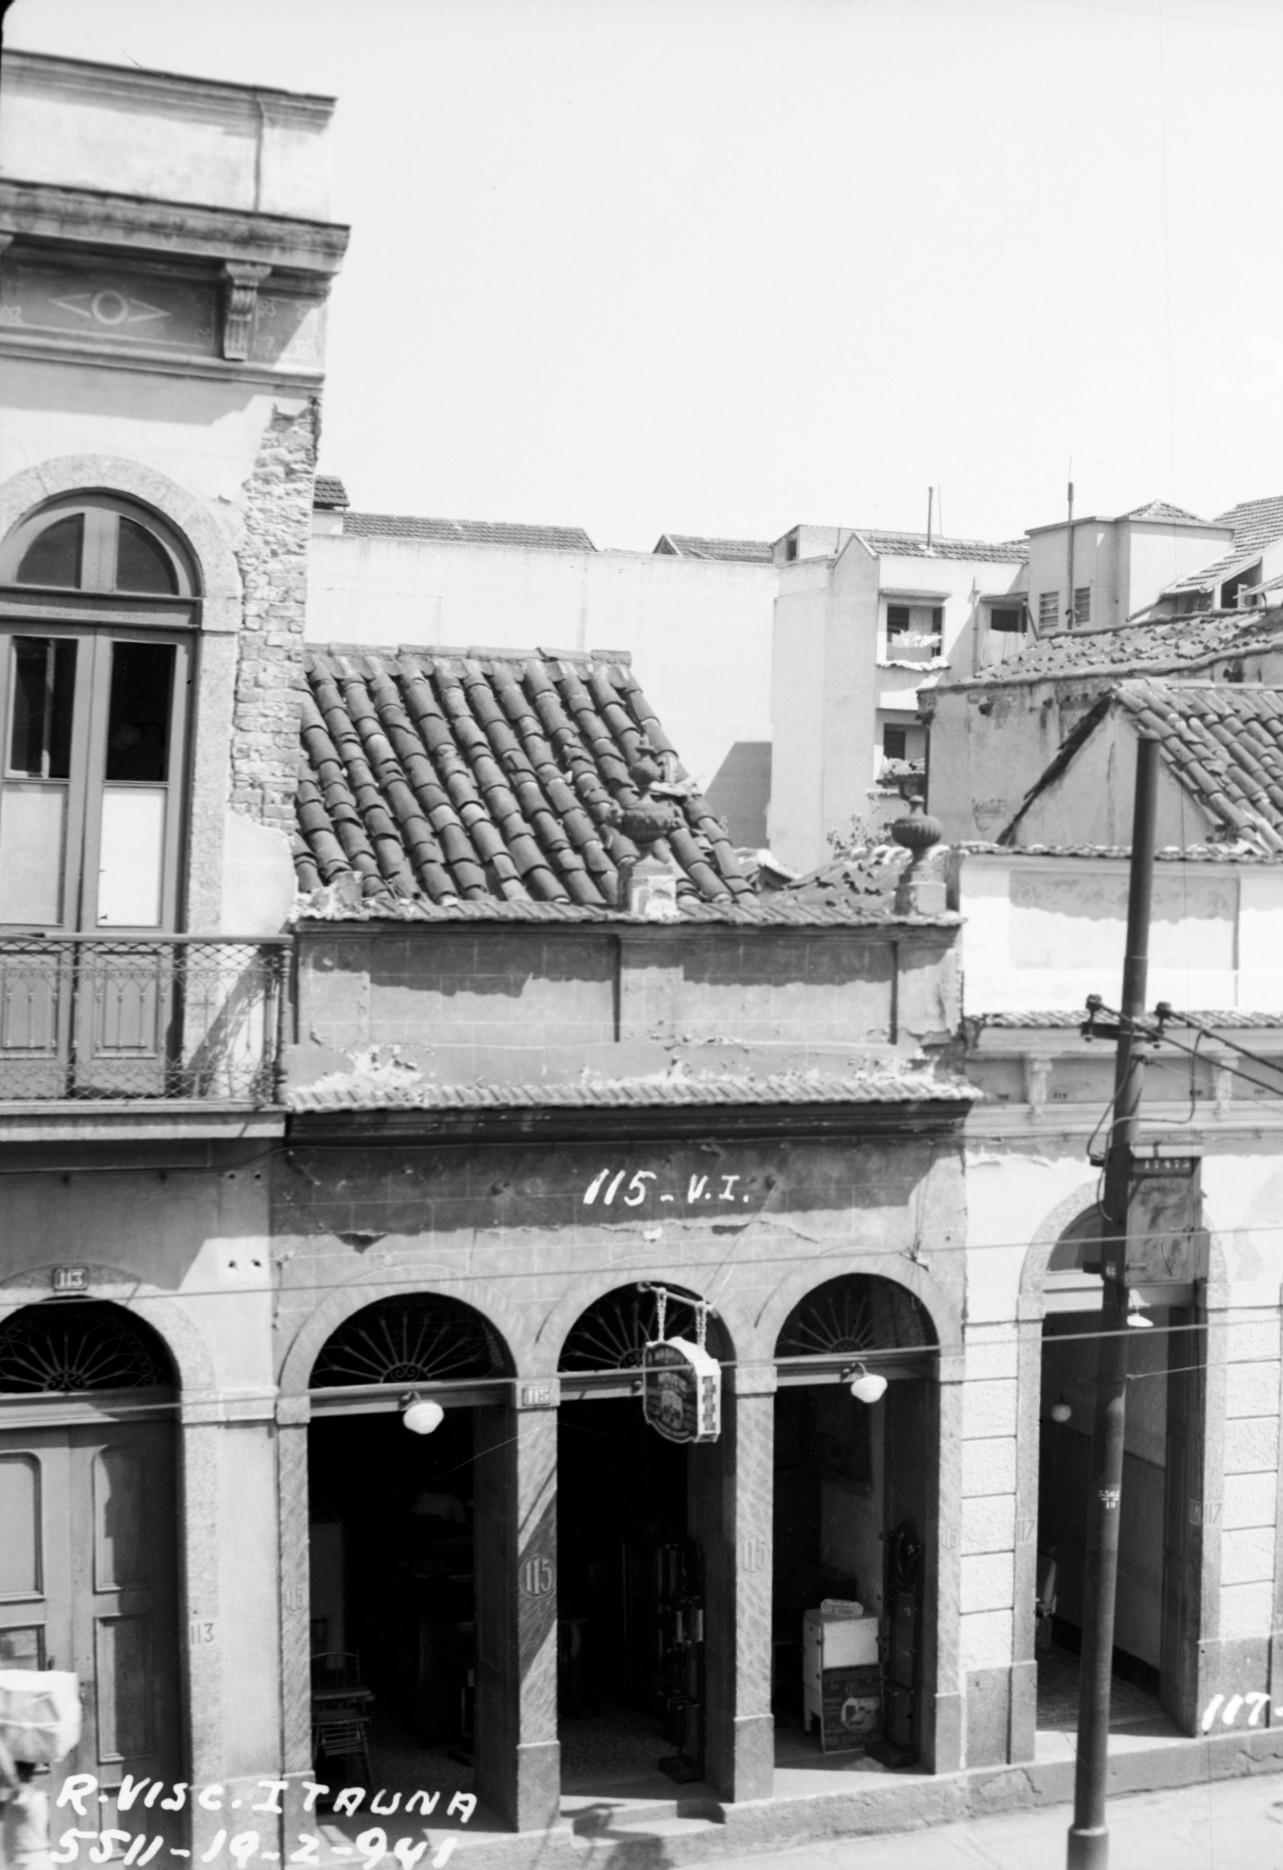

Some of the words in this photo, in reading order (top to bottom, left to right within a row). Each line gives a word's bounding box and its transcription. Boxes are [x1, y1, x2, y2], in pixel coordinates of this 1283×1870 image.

[60, 1271, 84, 1287] 113
[528, 1388, 550, 1402] 115
[1204, 1503, 1222, 1524] 117
[1017, 1520, 1036, 1541] 117
[525, 1558, 553, 1594] 115
[190, 1622, 214, 1645] 113
